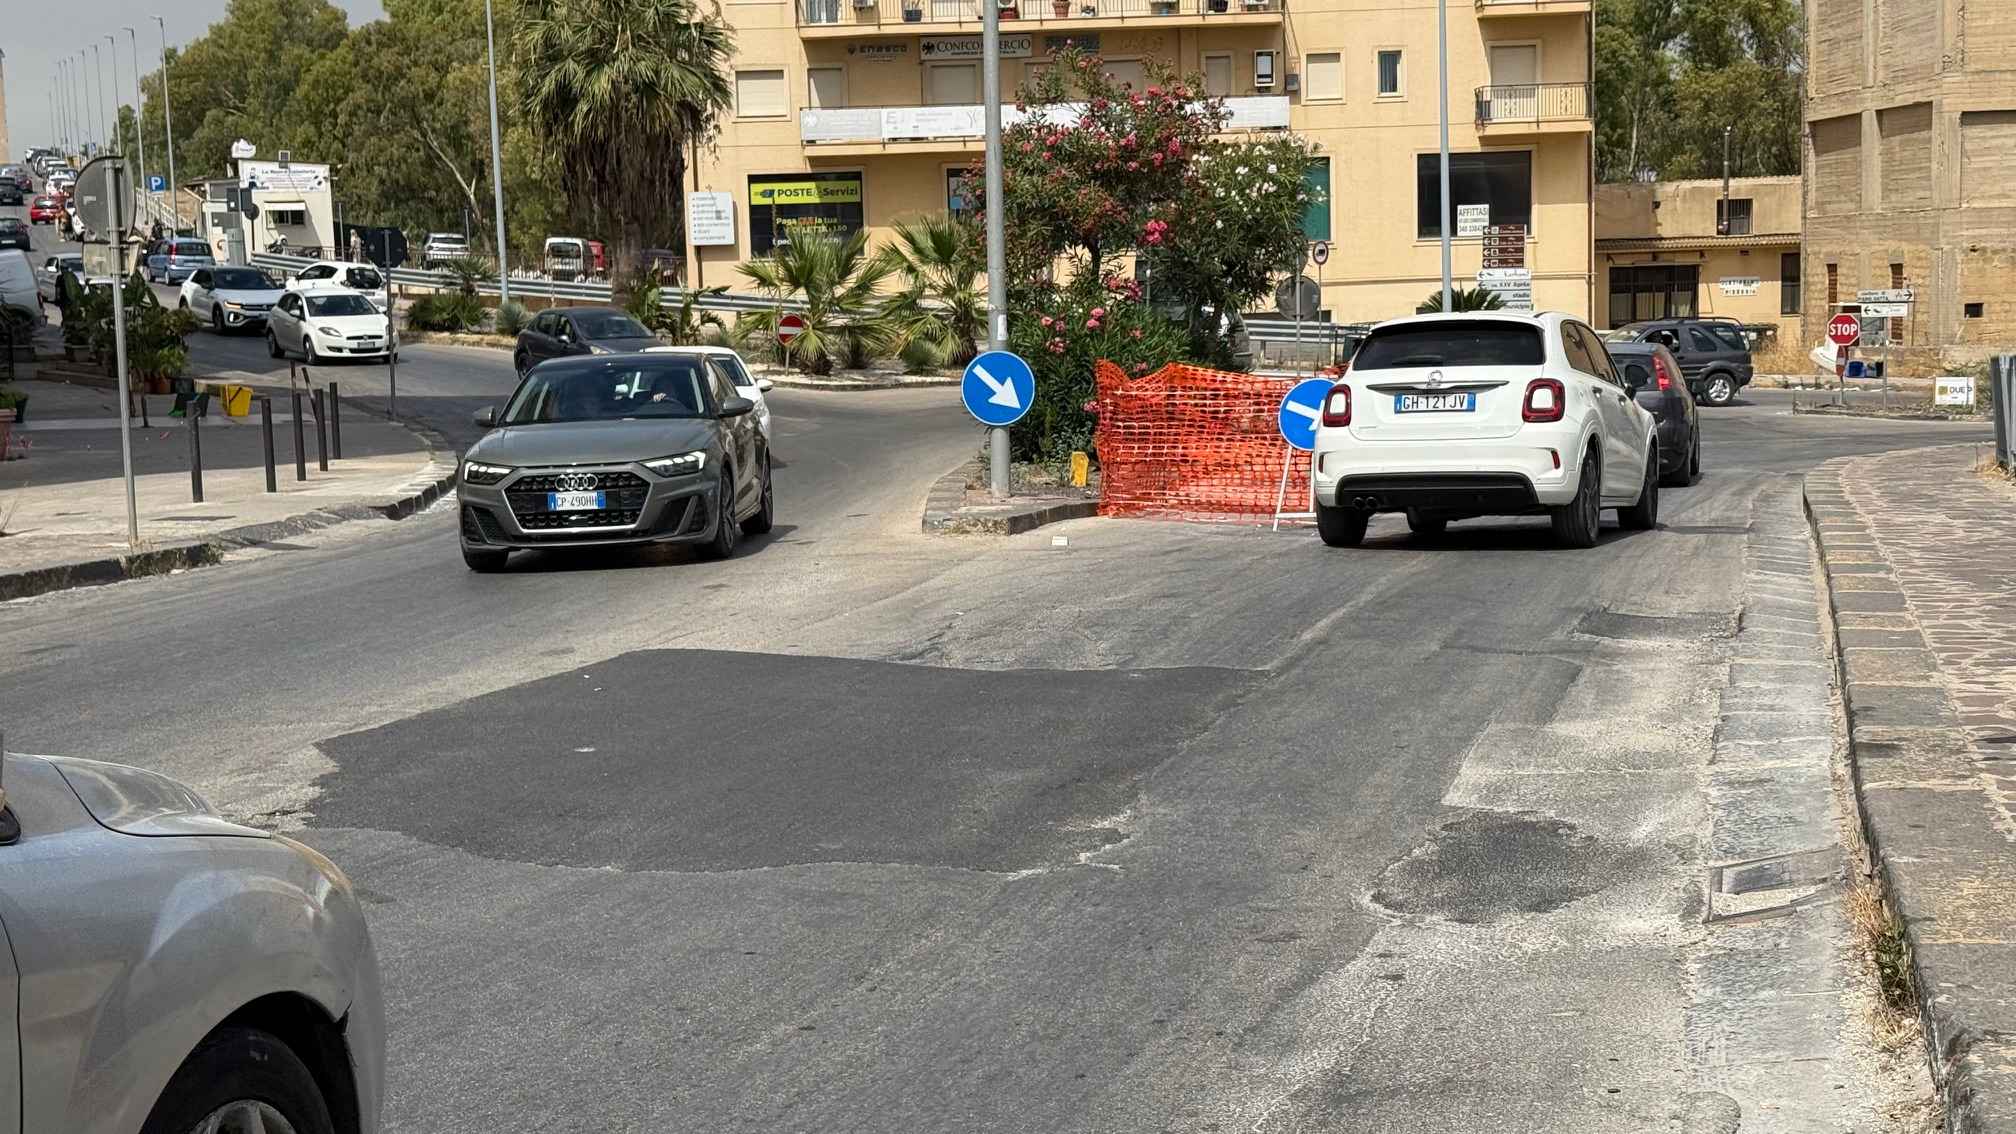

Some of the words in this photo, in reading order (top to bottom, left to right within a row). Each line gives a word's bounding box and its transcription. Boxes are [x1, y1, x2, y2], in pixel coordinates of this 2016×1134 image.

[151, 177, 161, 190] P
[822, 186, 858, 197] Servizi
[1829, 323, 1858, 336] STOP
[1403, 396, 1419, 409] GH
[1424, 394, 1465, 408] 121JV
